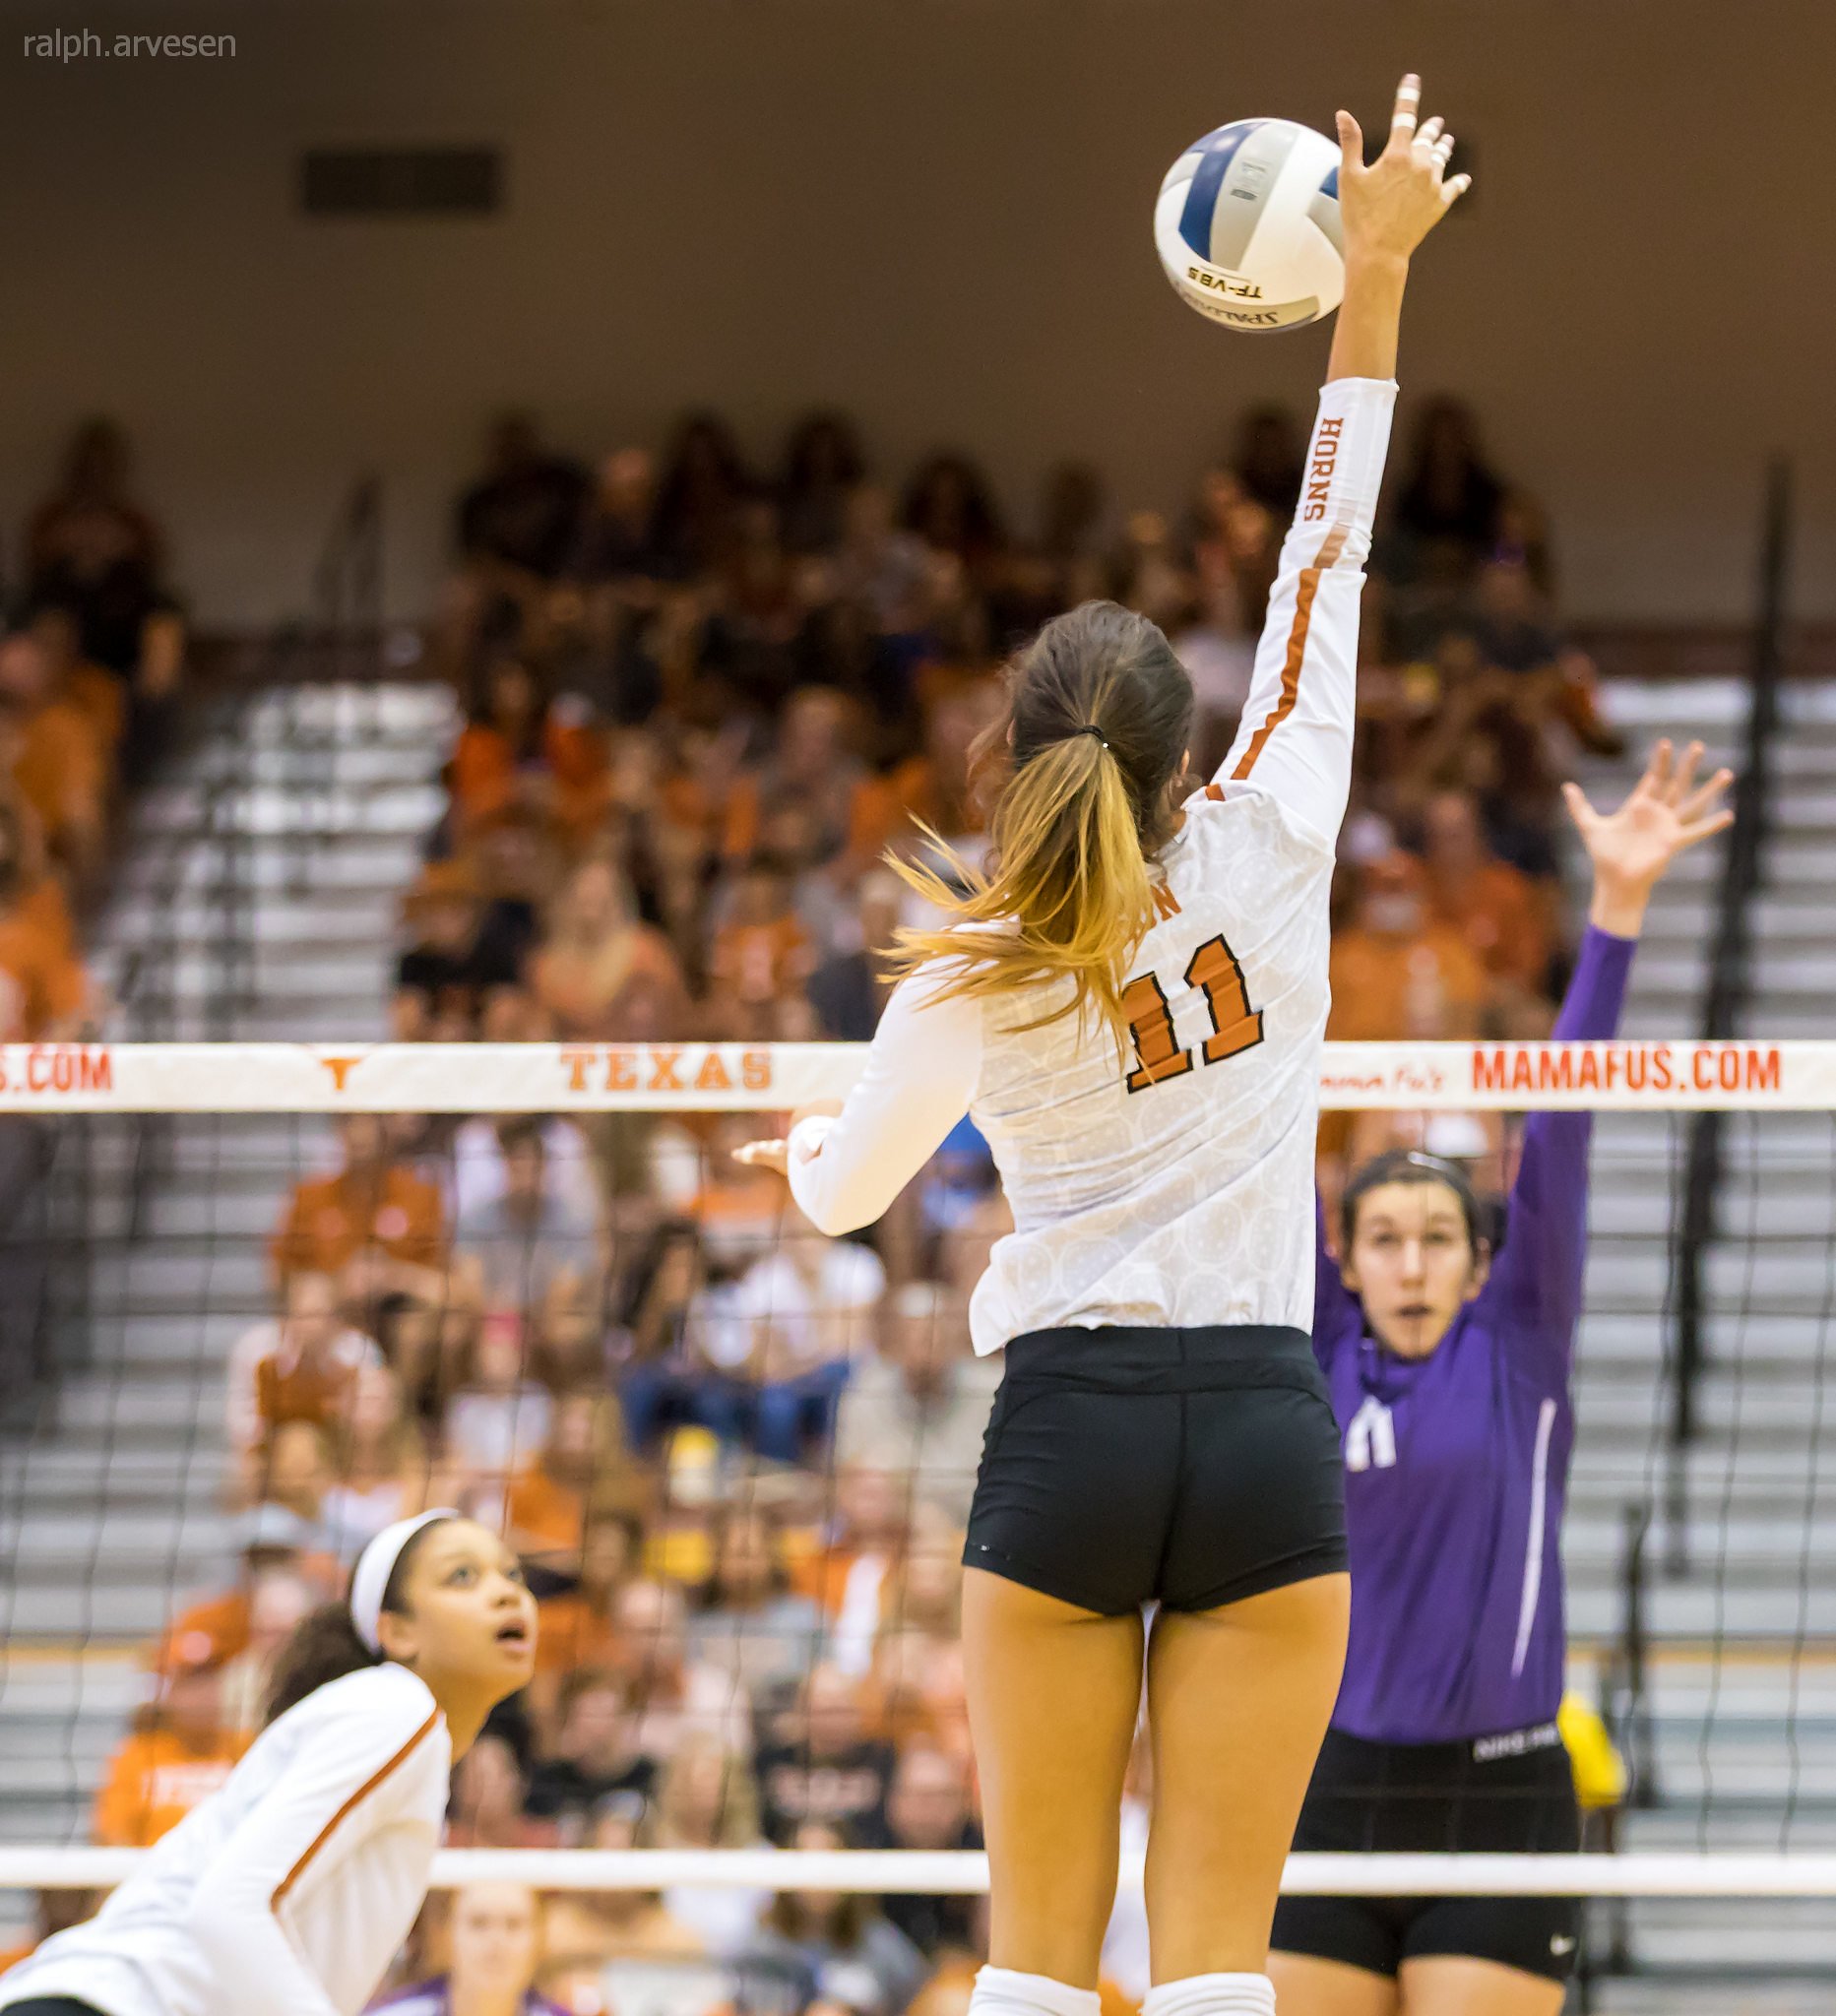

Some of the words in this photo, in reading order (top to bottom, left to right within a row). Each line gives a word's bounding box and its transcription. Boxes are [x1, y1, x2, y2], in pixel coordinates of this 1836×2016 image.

[1303, 417, 1344, 522] HORNS
[1121, 932, 1265, 1095] 11
[558, 1044, 774, 1092] TEXAS
[1472, 1044, 1782, 1092] MAMAFUS.COM
